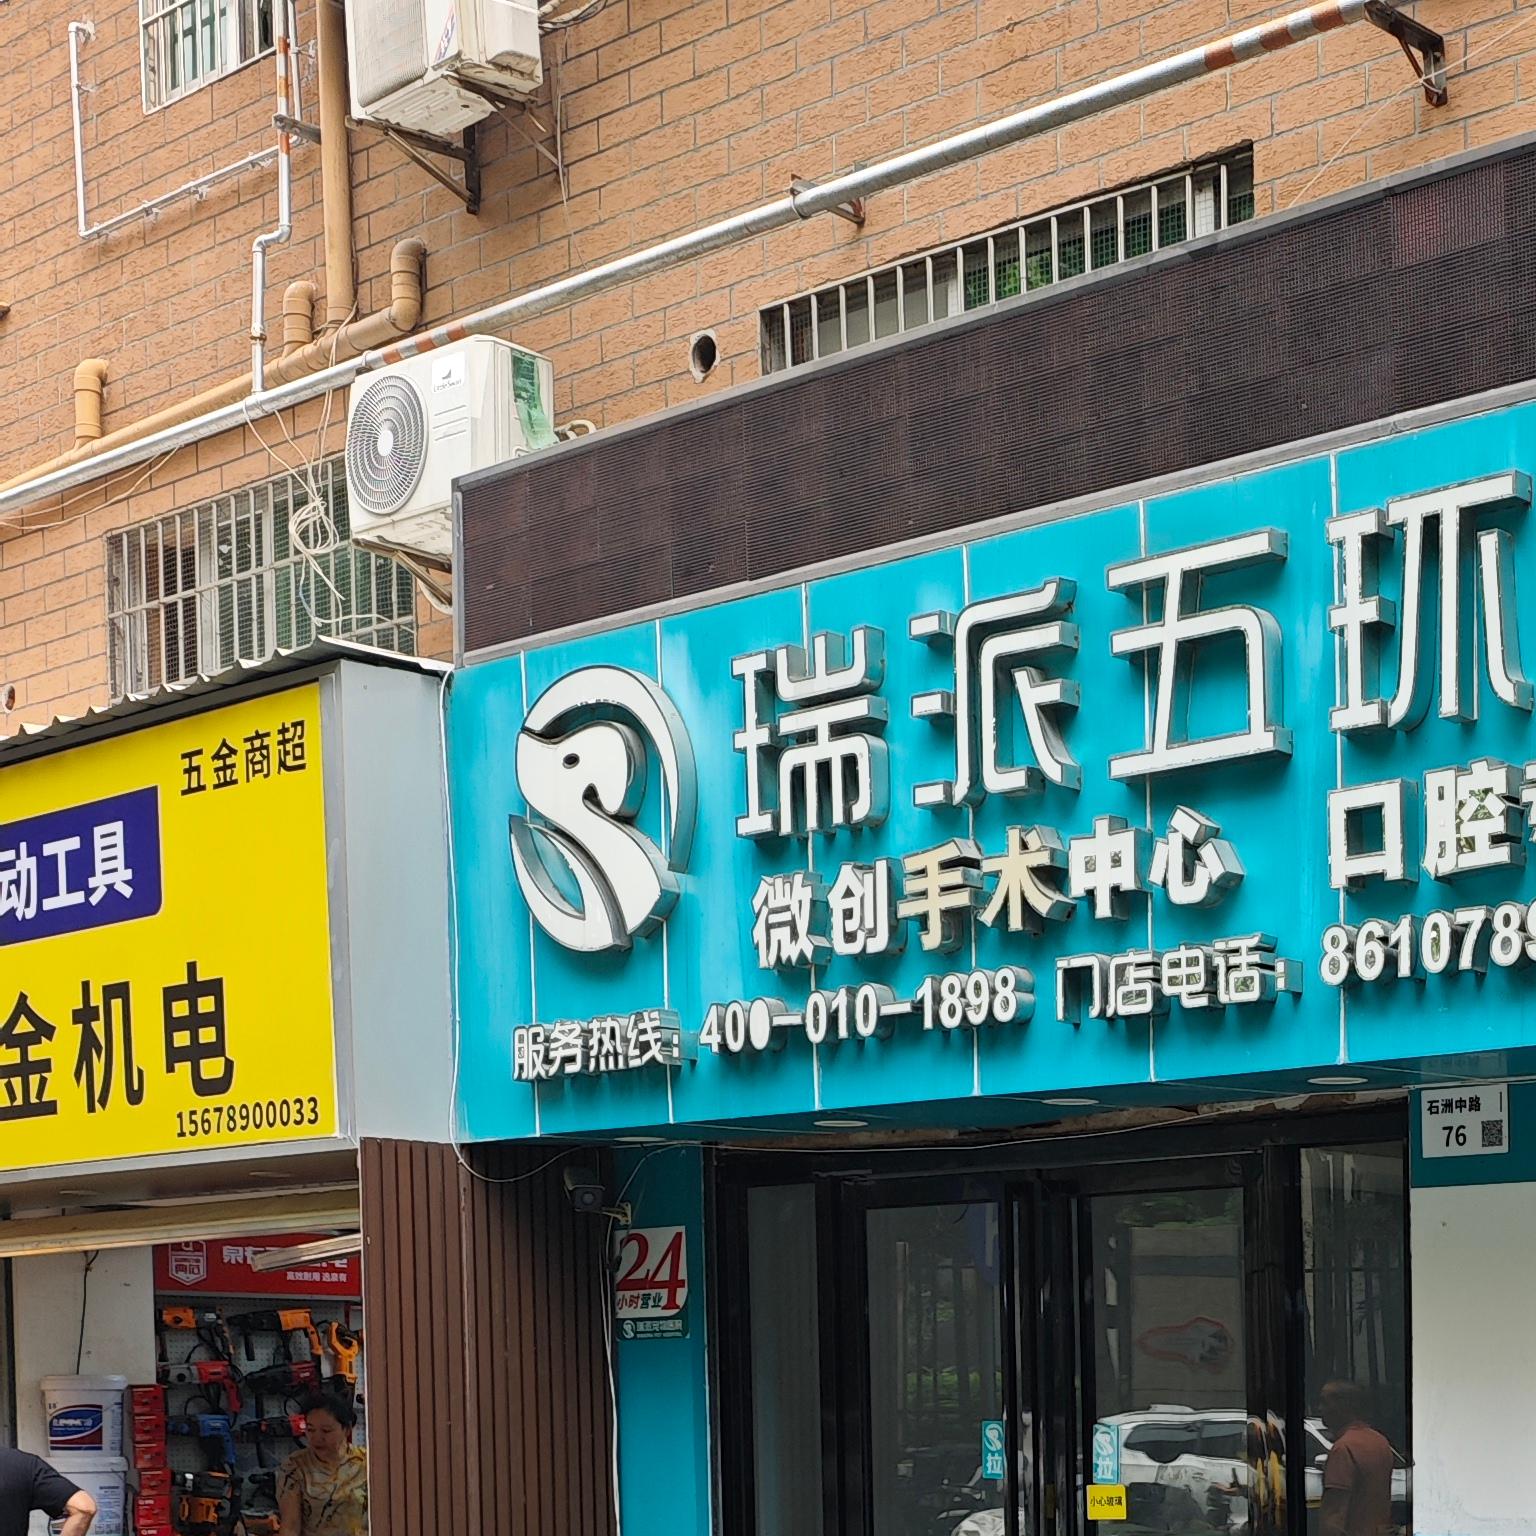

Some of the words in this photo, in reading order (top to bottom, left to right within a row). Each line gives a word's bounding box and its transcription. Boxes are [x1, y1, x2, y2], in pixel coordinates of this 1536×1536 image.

[180, 719, 307, 797] 五金商超
[0, 820, 134, 922] 动工具
[752, 804, 1245, 970] 微创手术中心
[699, 966, 1034, 1054] 400-010-1898
[0, 961, 235, 1122] 金机电
[176, 1097, 320, 1138] 15678900033
[1426, 1095, 1481, 1115] 石洲中路
[1442, 1125, 1467, 1147] 76
[616, 1231, 685, 1310] 24
[616, 1292, 663, 1311] 小时营业
[986, 1453, 1002, 1474] 拉
[1096, 1458, 1113, 1479] 拉
